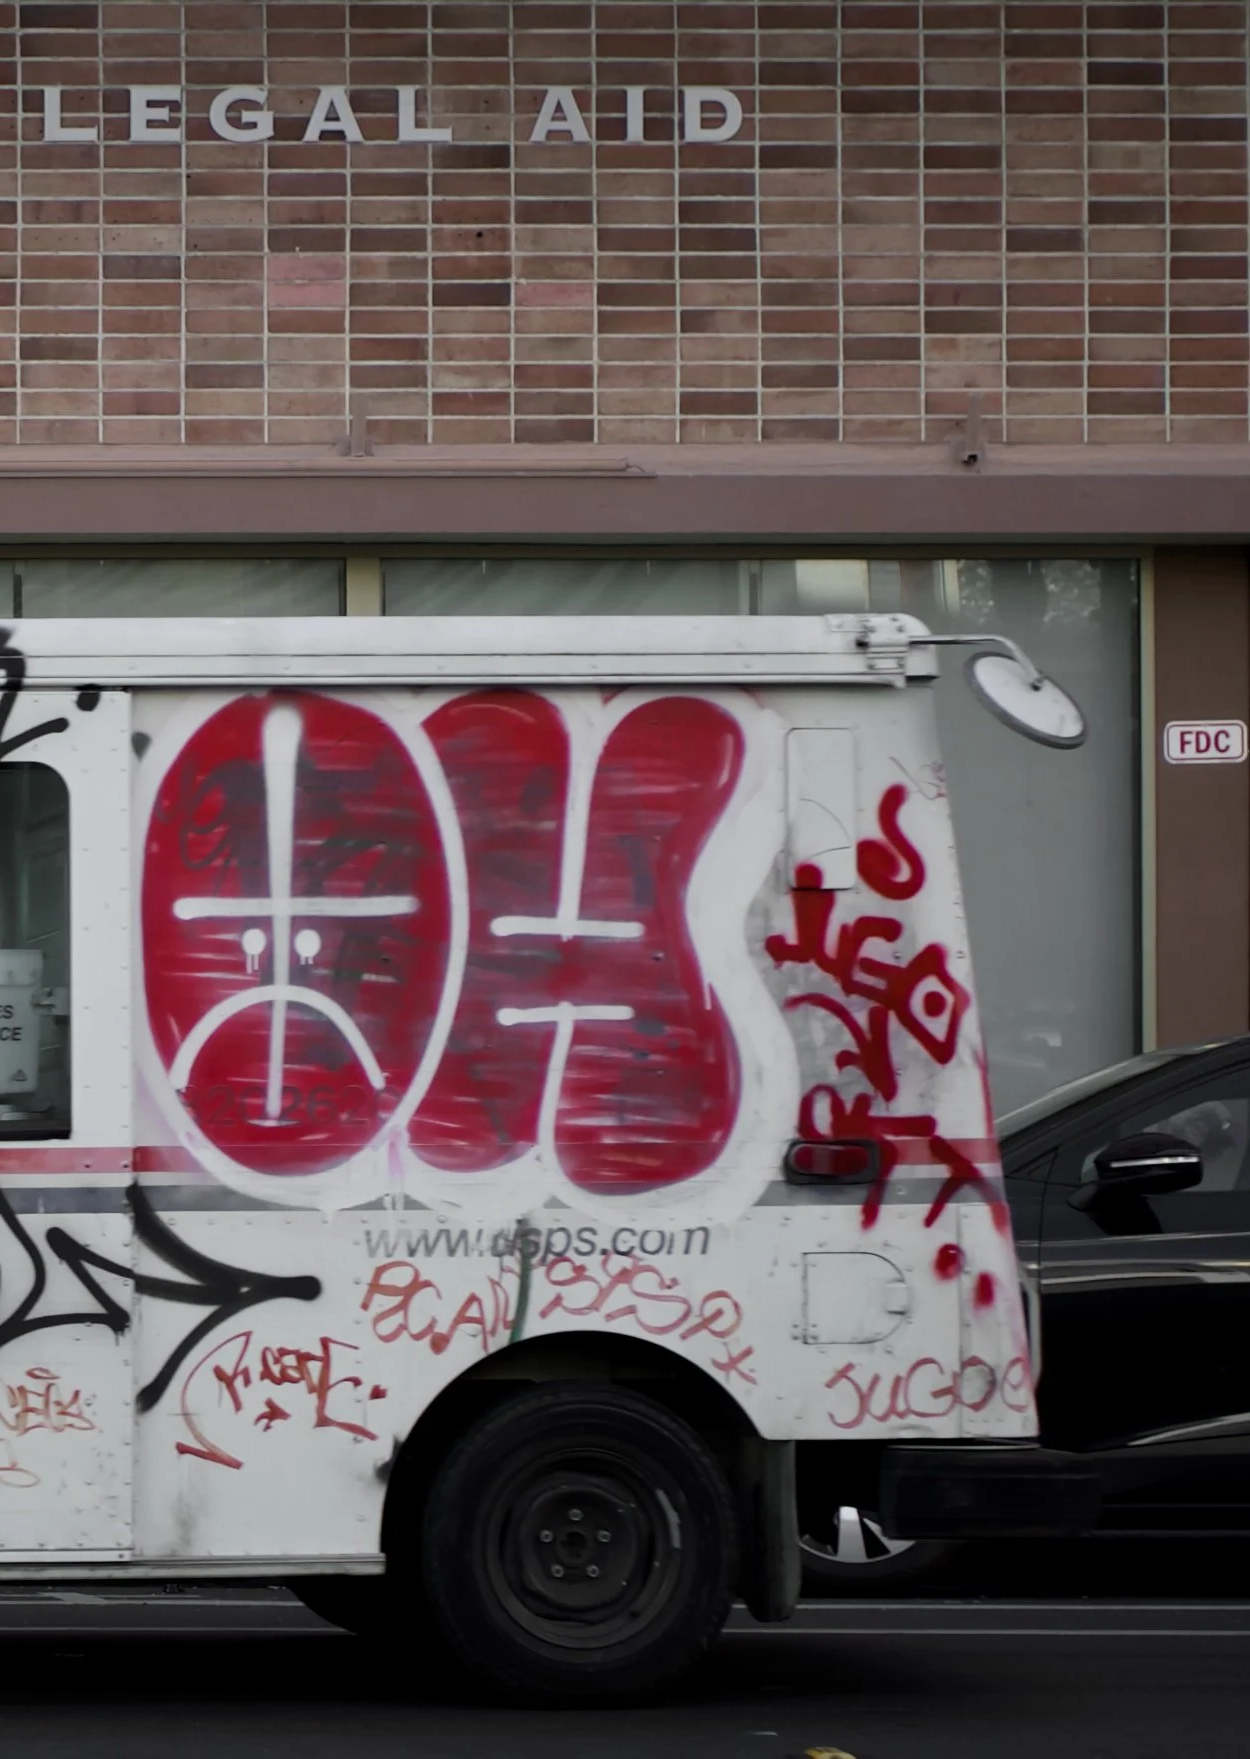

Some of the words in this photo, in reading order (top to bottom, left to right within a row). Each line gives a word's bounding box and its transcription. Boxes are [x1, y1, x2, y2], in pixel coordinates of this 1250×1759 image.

[41, 85, 454, 144] LEGAL
[528, 85, 745, 144] AID
[1179, 729, 1231, 754] FDC
